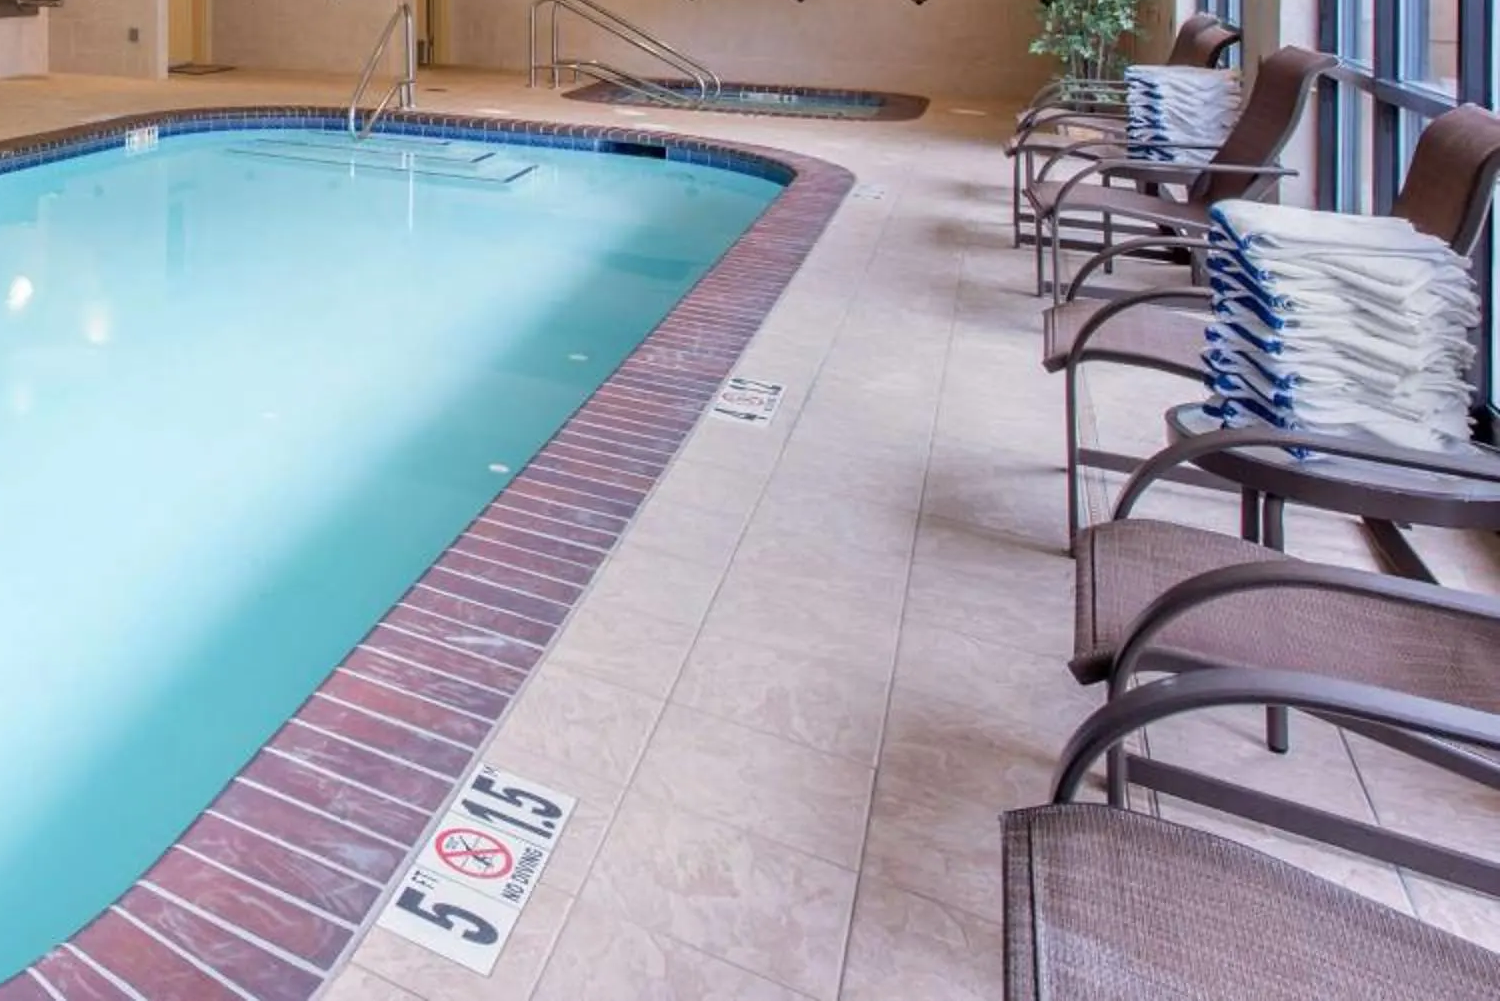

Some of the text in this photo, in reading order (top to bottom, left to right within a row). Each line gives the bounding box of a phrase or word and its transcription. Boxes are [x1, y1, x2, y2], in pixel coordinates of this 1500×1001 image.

[461, 774, 562, 839] 1.5
[411, 870, 437, 890] FT
[501, 847, 543, 902] NO DIVING
[396, 887, 498, 945] 5
